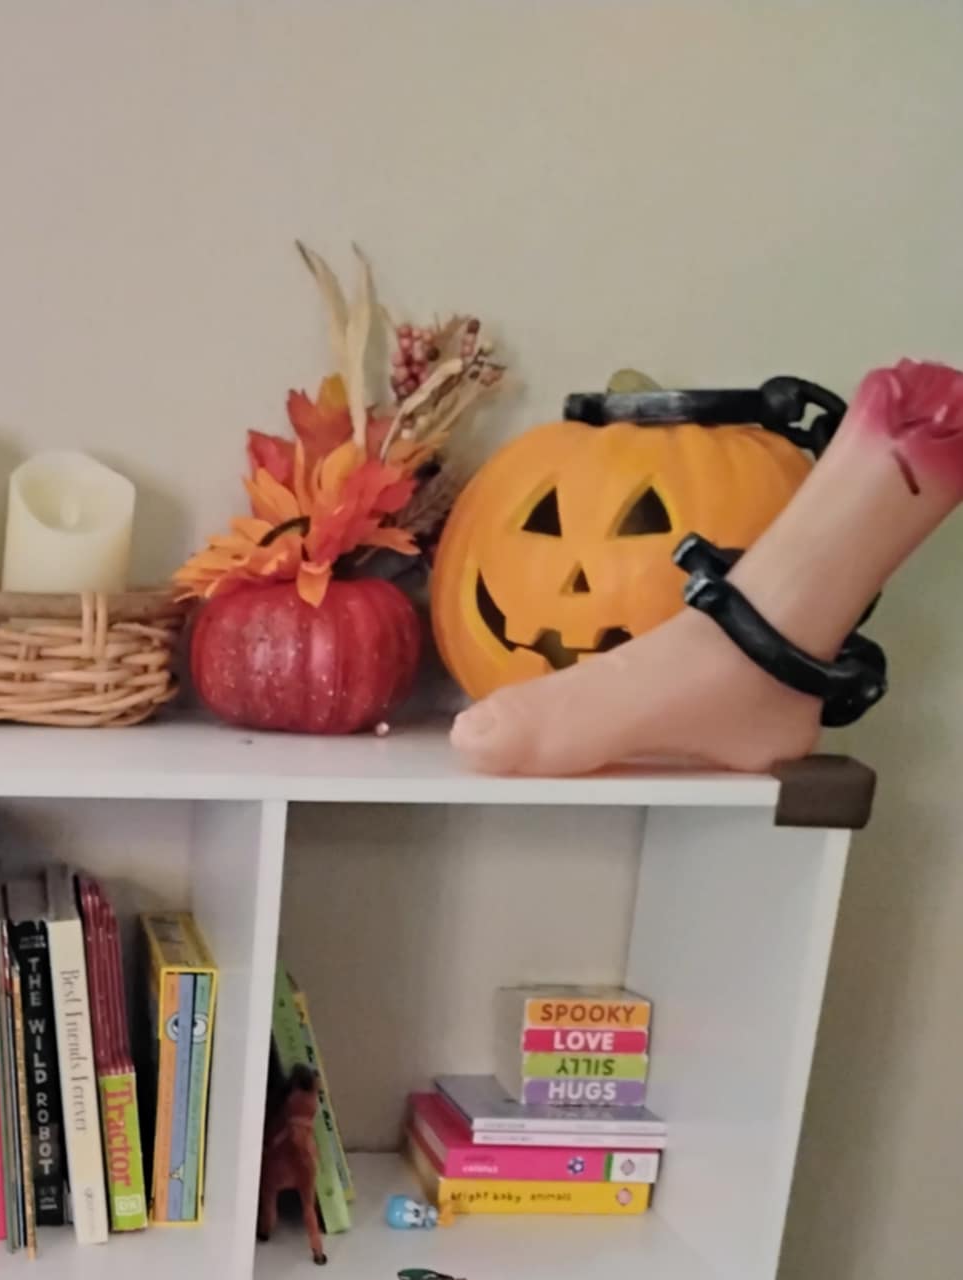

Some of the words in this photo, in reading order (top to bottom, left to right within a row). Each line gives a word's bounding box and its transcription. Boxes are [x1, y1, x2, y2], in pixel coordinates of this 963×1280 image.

[27, 957, 43, 1007] THE
[60, 970, 83, 1004] Best
[540, 1004, 636, 1023] SPOOKY
[28, 1018, 48, 1085] WILD
[553, 1031, 615, 1051] LOVE
[555, 1058, 615, 1076] SILLY
[548, 1081, 617, 1101] HUGS
[36, 1092, 54, 1175] ROBOT
[103, 1080, 134, 1188] Tractor
